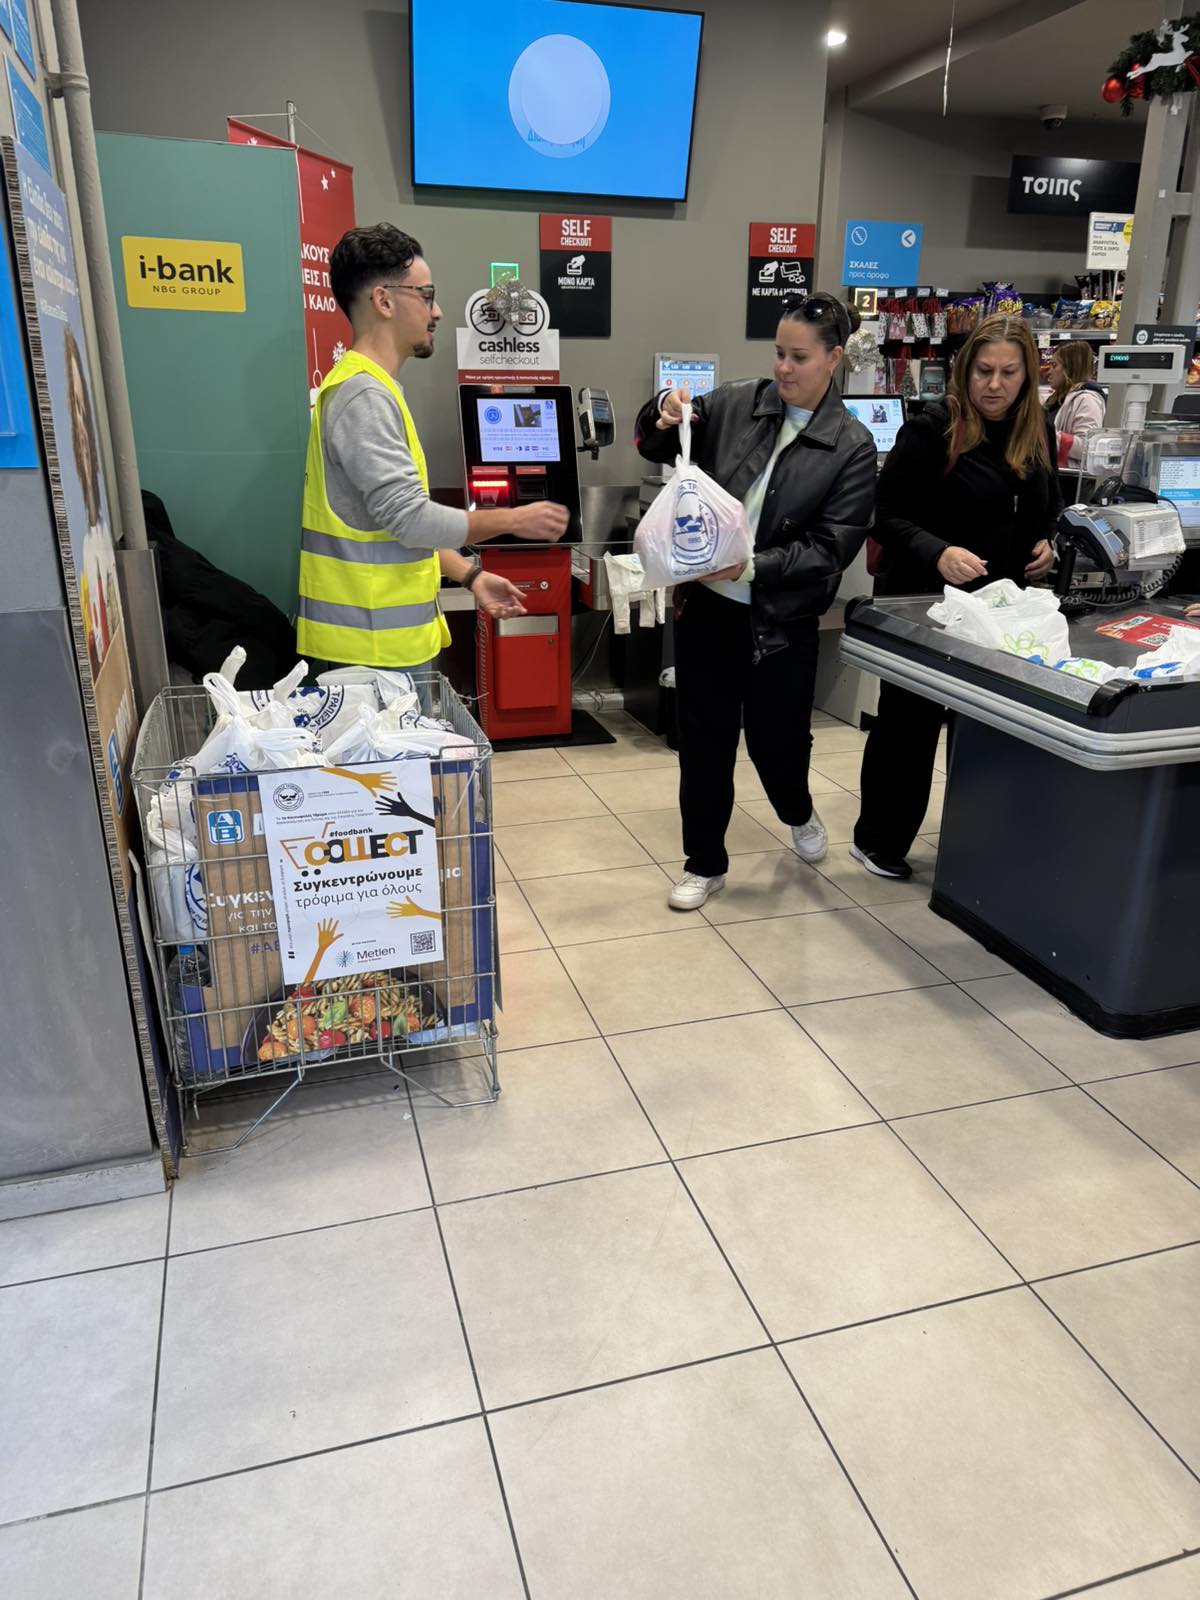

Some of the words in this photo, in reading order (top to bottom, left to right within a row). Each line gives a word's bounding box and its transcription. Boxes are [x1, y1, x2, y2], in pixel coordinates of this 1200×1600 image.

[1022, 176, 1082, 202] τσιπς
[561, 219, 591, 236] SELF
[770, 227, 797, 243] SELF
[560, 237, 592, 246] CHECKOUT
[768, 244, 797, 253] CHECKOUT
[139, 255, 234, 284] i-bank
[849, 261, 879, 269] ΣΚΑΛΕΣ
[848, 271, 866, 279] προς
[866, 271, 890, 279] όροφο
[557, 277, 575, 286] ΜΟΝΟ
[576, 277, 595, 287] ΚΑΡΤΑ
[153, 285, 177, 294] NBG
[182, 286, 221, 295] GROUP
[862, 295, 870, 307] 2
[478, 337, 540, 352] cashless
[480, 354, 540, 365] selfcheckout
[329, 827, 374, 837] #foodbank
[304, 830, 423, 866] COLLECT
[294, 867, 423, 892] Συγκεντρώνουμε
[296, 892, 354, 909] τρόφιμα
[357, 888, 378, 902] για
[382, 883, 422, 897] όλους
[239, 924, 258, 933] και
[356, 947, 396, 960] Metlen
